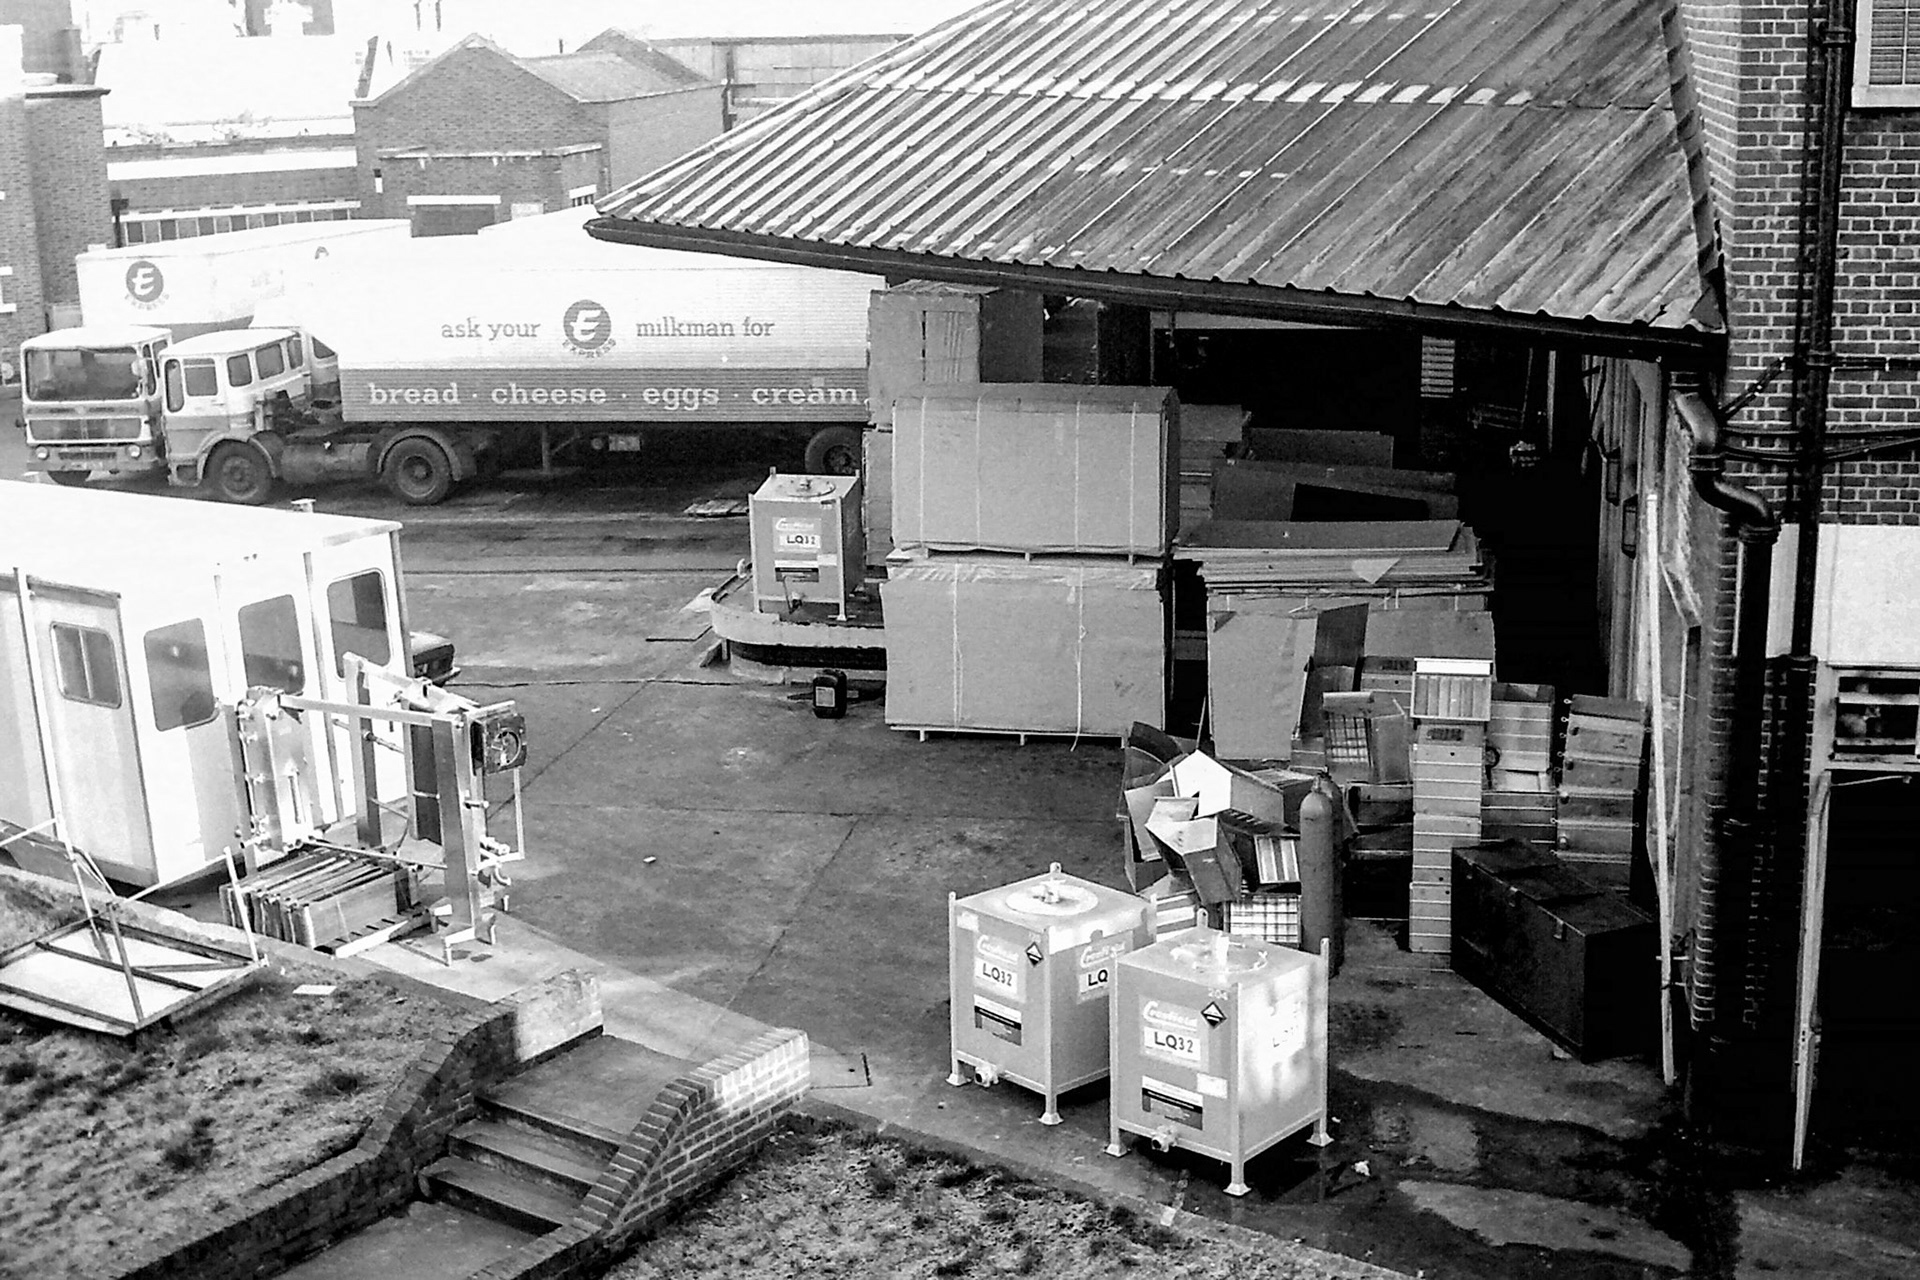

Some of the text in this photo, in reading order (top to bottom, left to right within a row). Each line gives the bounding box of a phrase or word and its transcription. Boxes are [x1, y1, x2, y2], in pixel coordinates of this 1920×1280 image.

[441, 316, 482, 338] ask
[487, 322, 542, 341] your
[636, 316, 735, 338] milkman
[742, 316, 776, 337] for
[368, 381, 861, 411] bread cheese eggs cream
[982, 962, 1013, 987] LQ32
[1154, 1031, 1194, 1054] LQ32
